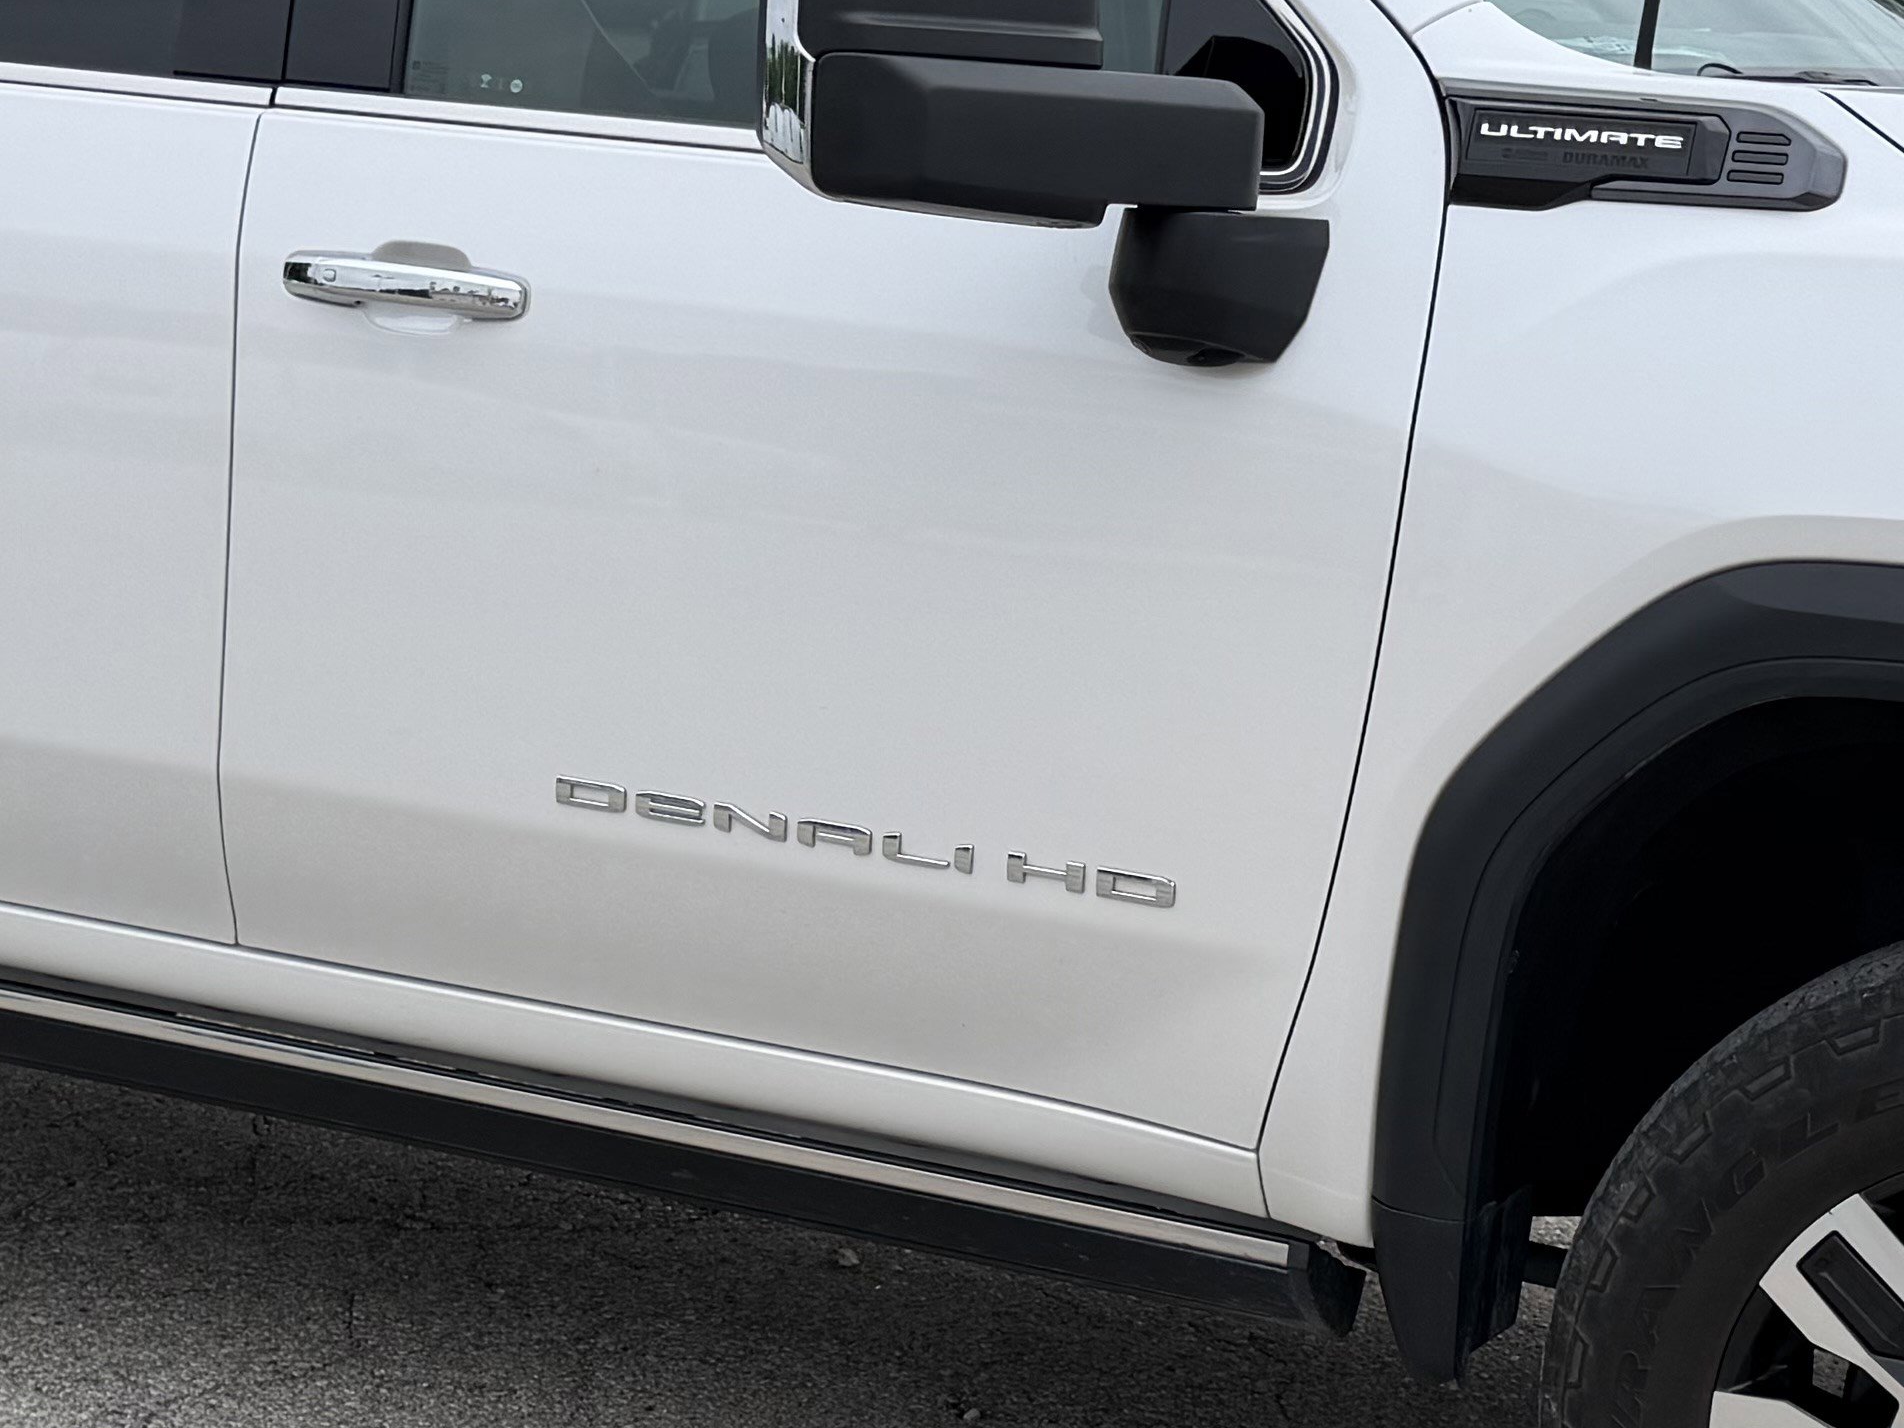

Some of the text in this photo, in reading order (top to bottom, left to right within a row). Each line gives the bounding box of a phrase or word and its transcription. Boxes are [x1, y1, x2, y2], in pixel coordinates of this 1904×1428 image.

[1480, 122, 1684, 149] ULTIMATE
[1561, 151, 1649, 169] DURAMAX
[555, 774, 1177, 909] DENALI HD
